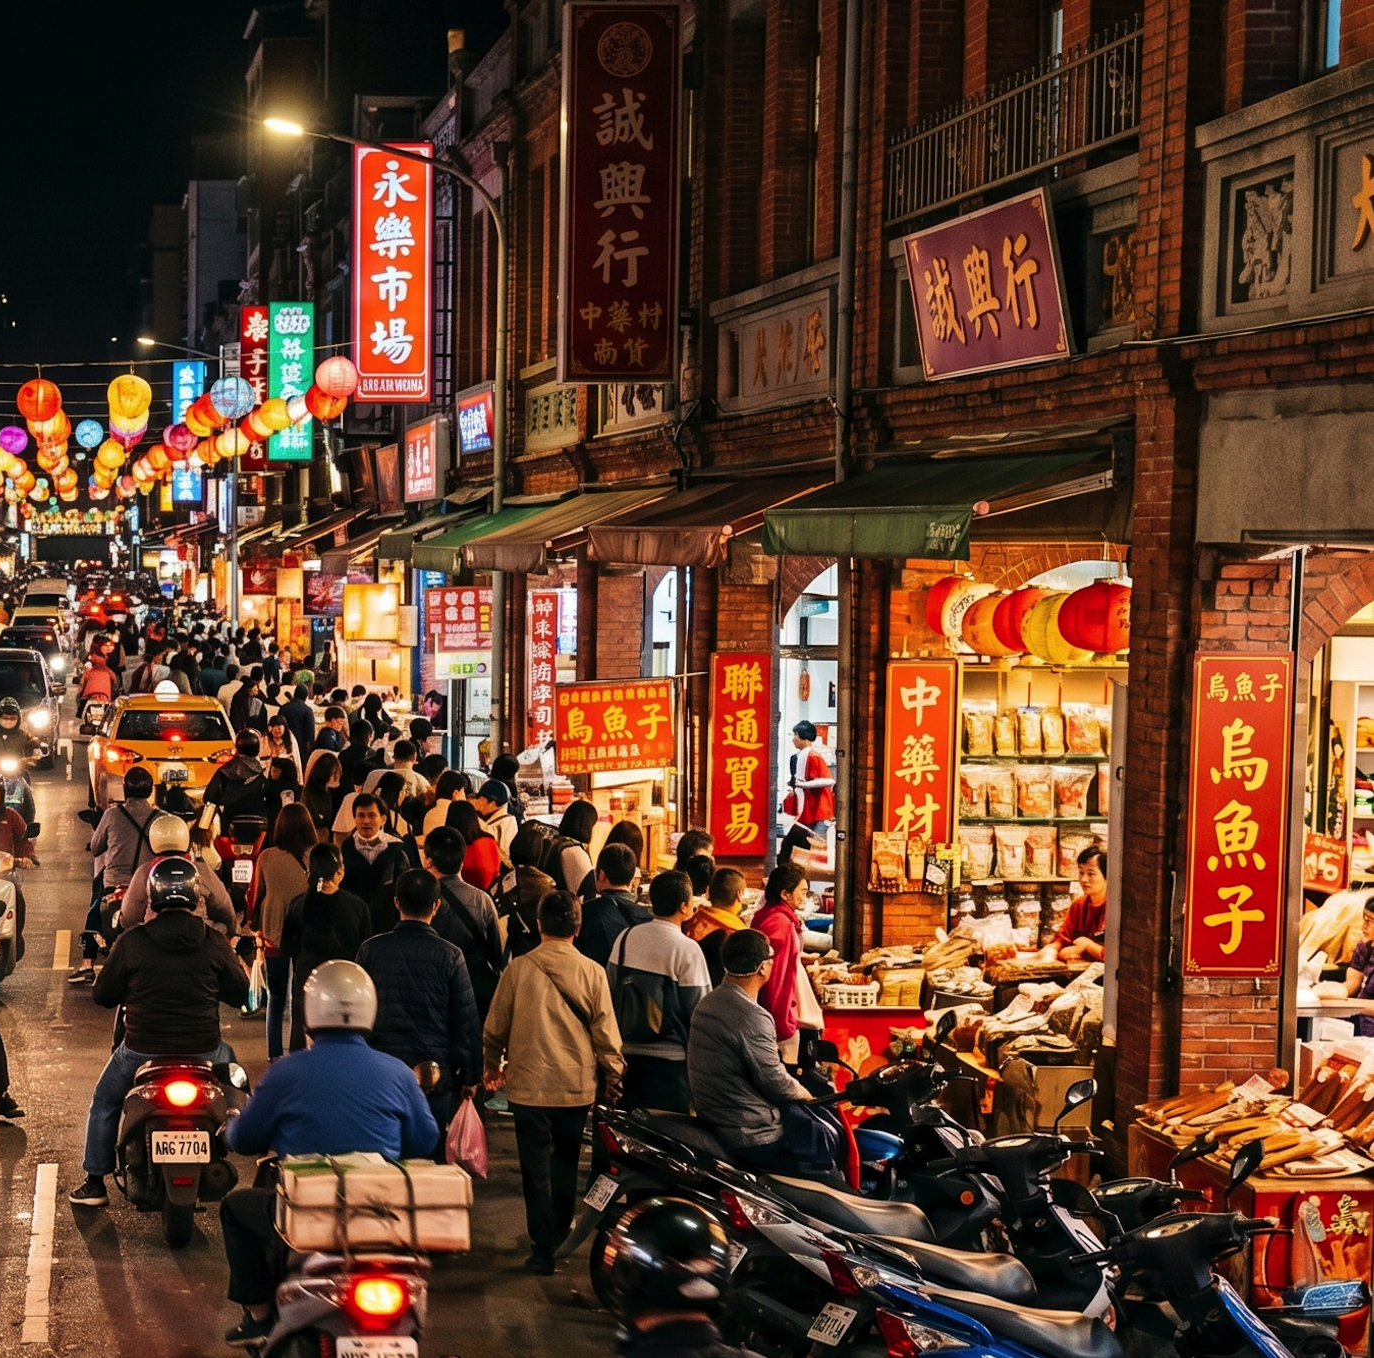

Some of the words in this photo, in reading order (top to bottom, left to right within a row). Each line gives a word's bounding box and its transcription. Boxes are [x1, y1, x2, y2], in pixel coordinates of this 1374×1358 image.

[369, 160, 418, 365] 永樂市場
[592, 87, 654, 288] 誠興行
[924, 233, 1038, 345] 誠興行
[721, 661, 764, 844] 聯通貿易
[893, 676, 942, 841] 中藥材
[1206, 672, 1284, 703] 烏魚子
[1203, 717, 1269, 955] 烏魚子
[178, 1141, 207, 1155] 7704
